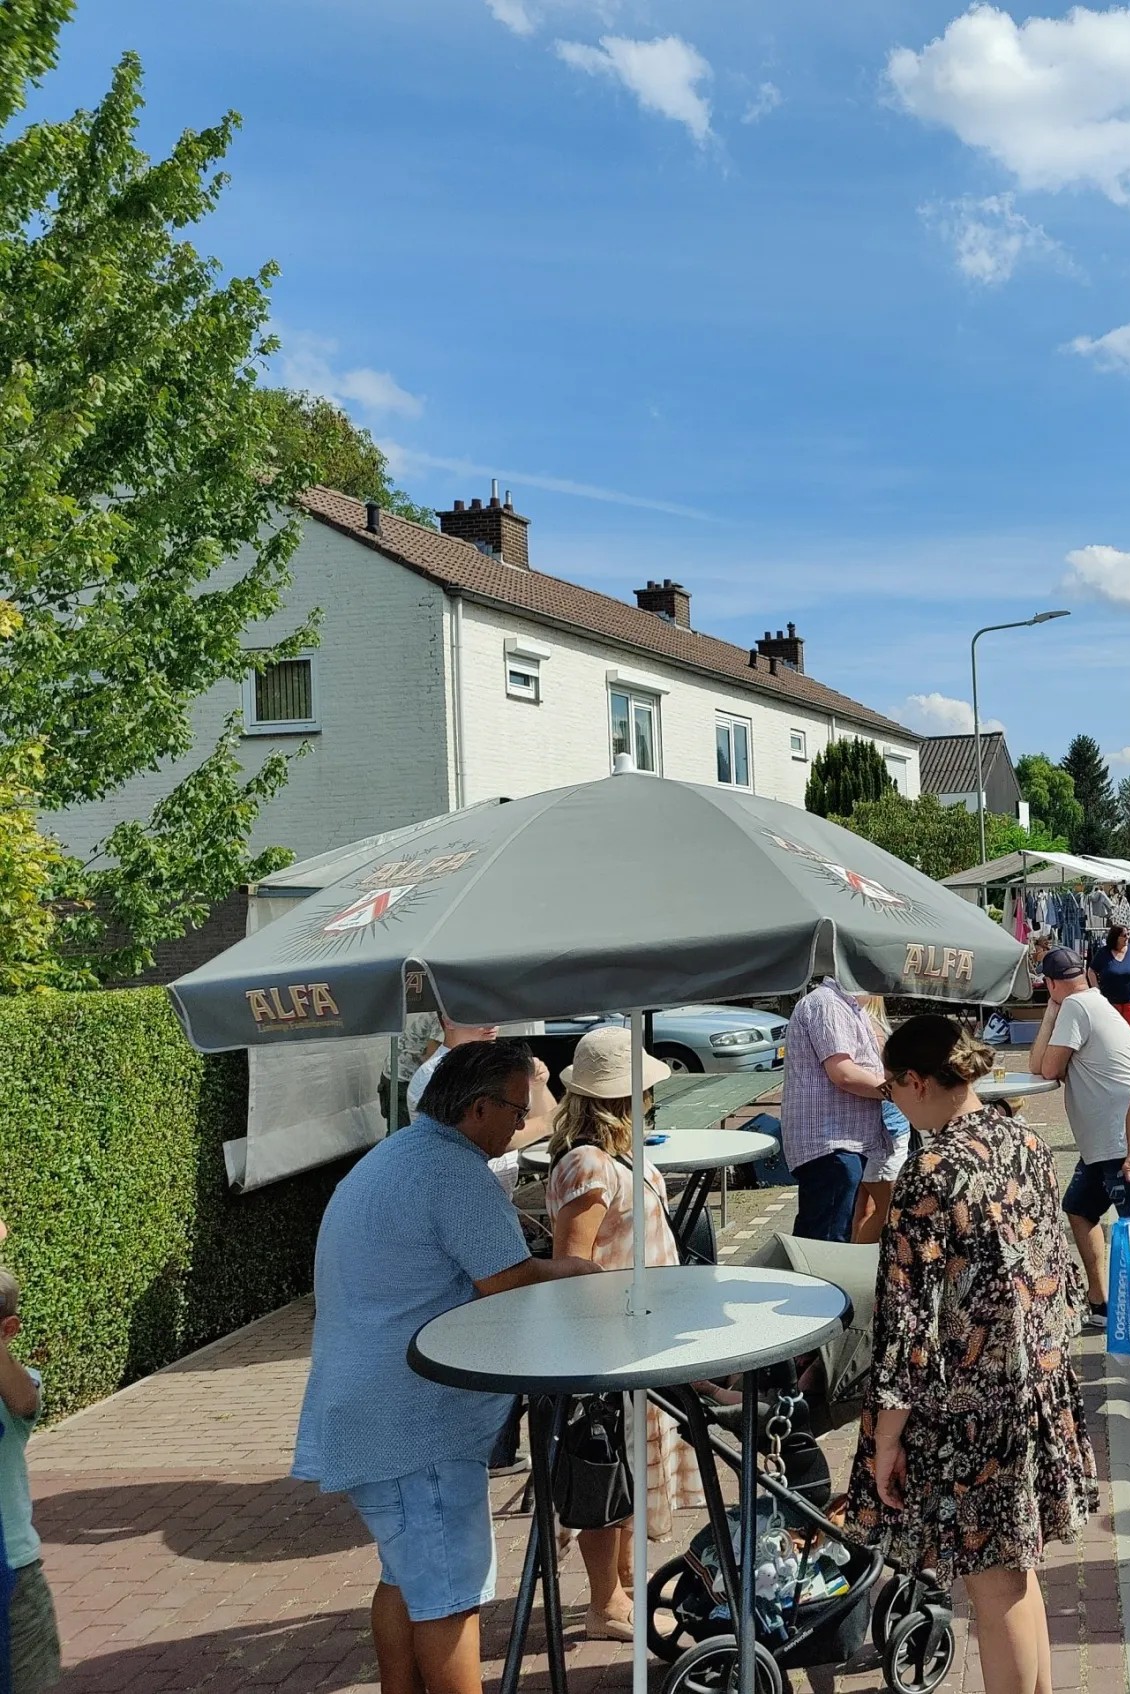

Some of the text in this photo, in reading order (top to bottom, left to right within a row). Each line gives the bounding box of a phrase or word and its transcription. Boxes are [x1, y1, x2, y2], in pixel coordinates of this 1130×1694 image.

[361, 848, 479, 884] ALFA
[903, 943, 975, 981] ALFA
[245, 982, 340, 1022] ALFA
